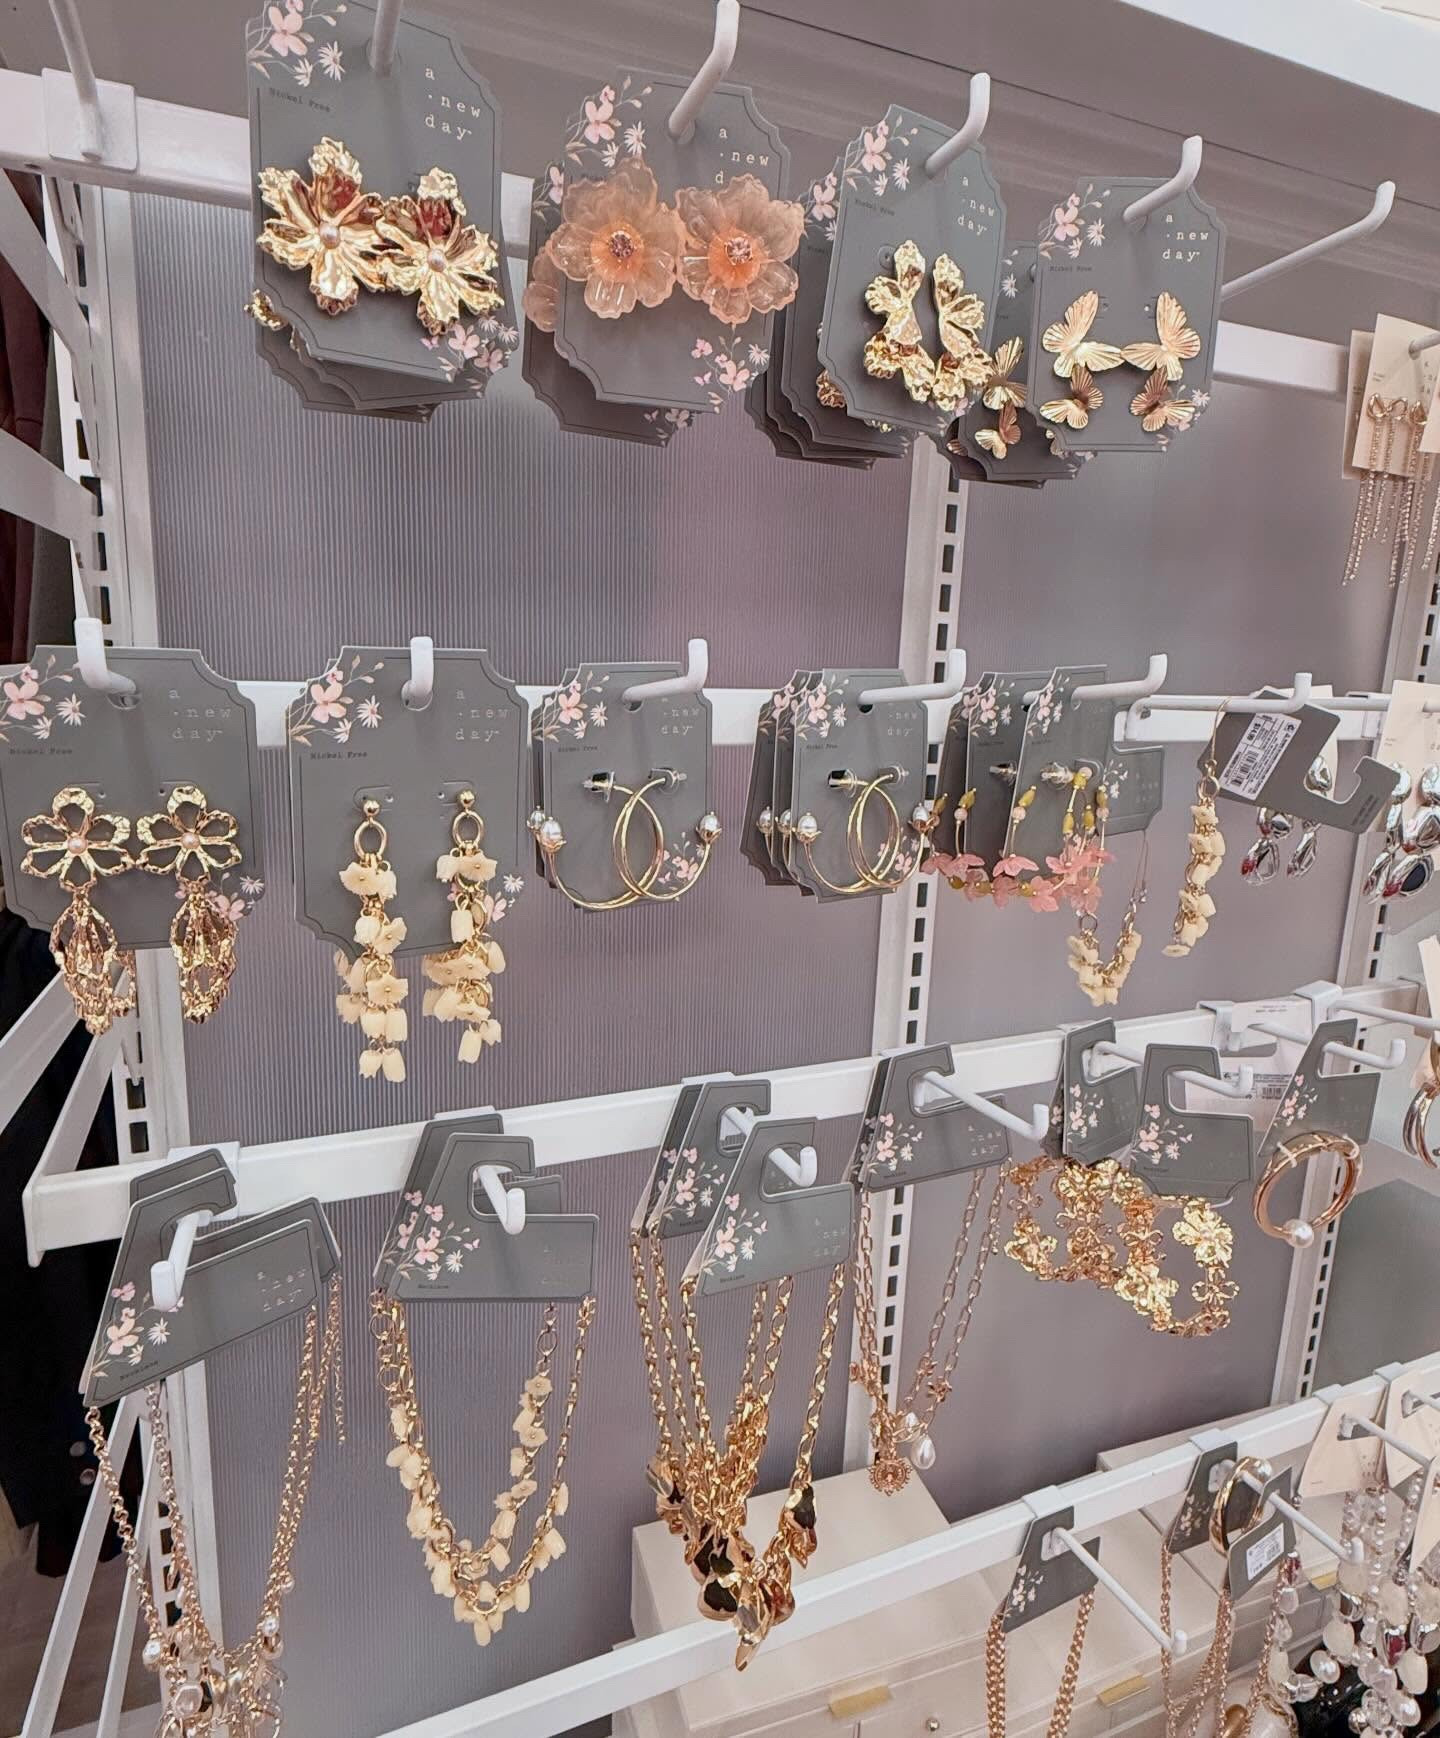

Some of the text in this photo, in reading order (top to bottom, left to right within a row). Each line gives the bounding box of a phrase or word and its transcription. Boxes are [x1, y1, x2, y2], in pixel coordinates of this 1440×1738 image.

[425, 66, 435, 80] a
[425, 113, 466, 140] day
[718, 127, 728, 139] a
[1165, 213, 1173, 223] a
[1162, 249, 1196, 262] day
[168, 689, 180, 699] a
